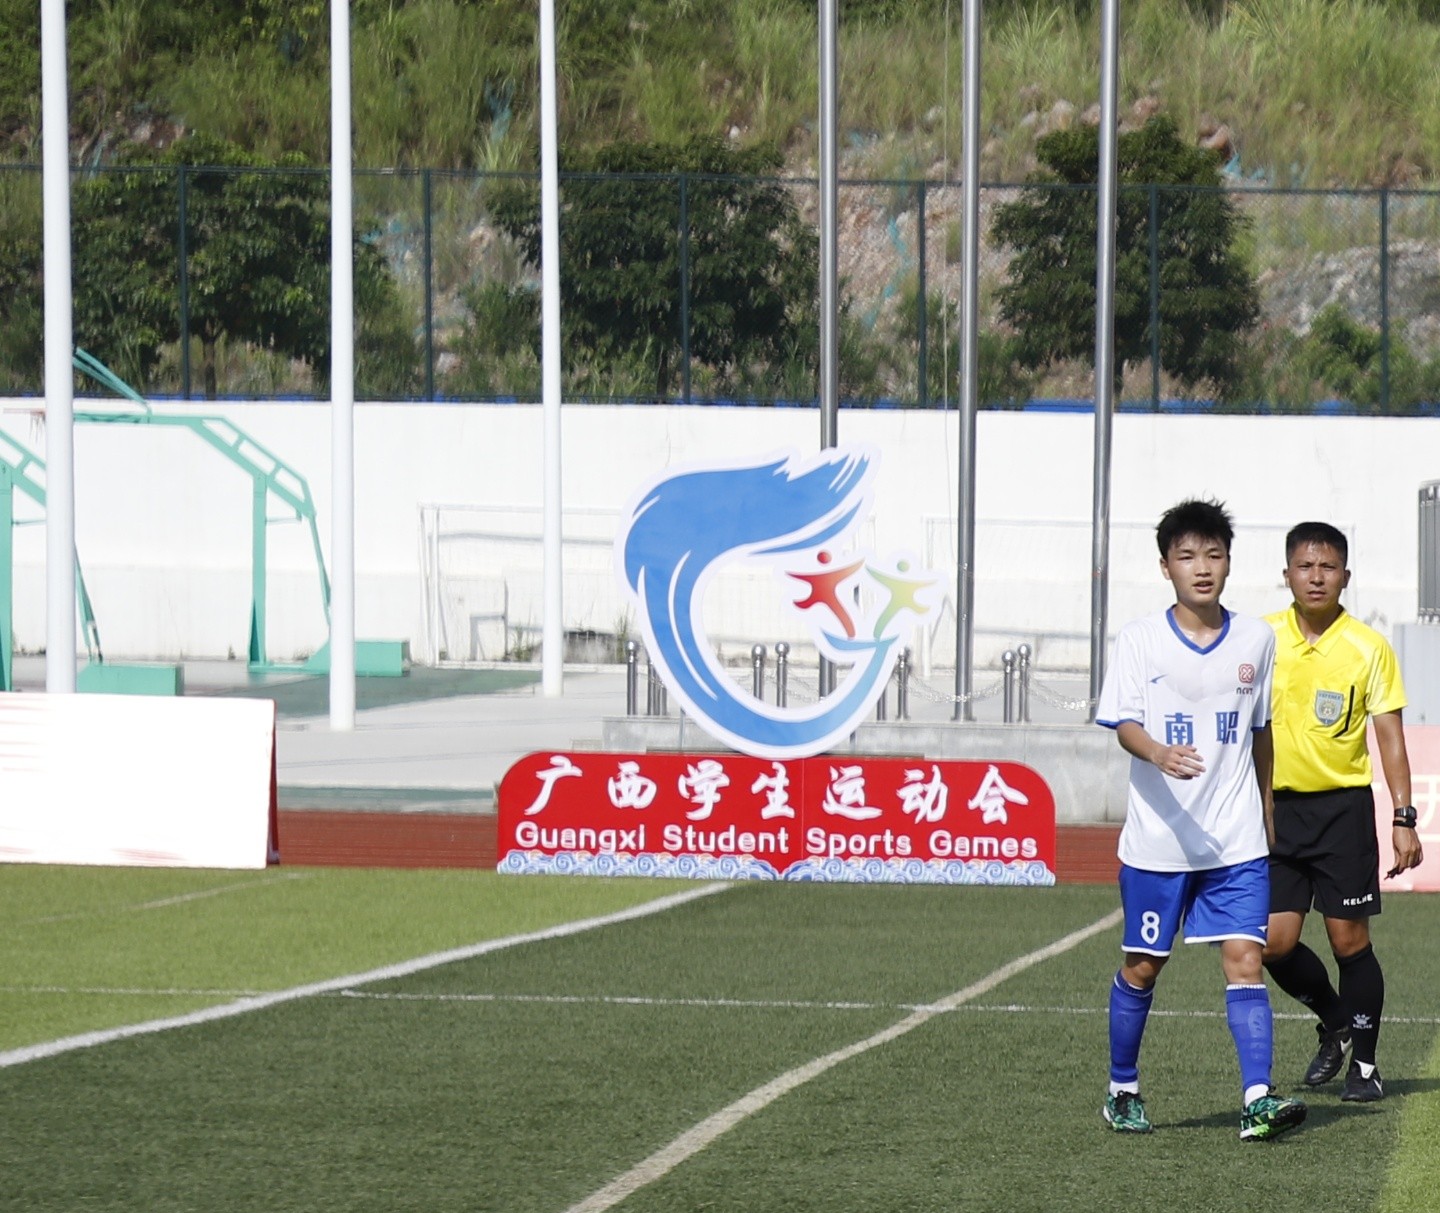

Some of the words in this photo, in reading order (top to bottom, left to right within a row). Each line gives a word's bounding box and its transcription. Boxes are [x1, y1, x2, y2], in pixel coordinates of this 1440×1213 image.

[1164, 711, 1239, 746] 南职
[524, 754, 1030, 825] 广西学生运动会
[515, 821, 646, 854] Guangxi
[663, 824, 789, 853] Student
[806, 827, 912, 859] Sports
[929, 829, 1038, 858] Games
[1140, 910, 1161, 945] 8
